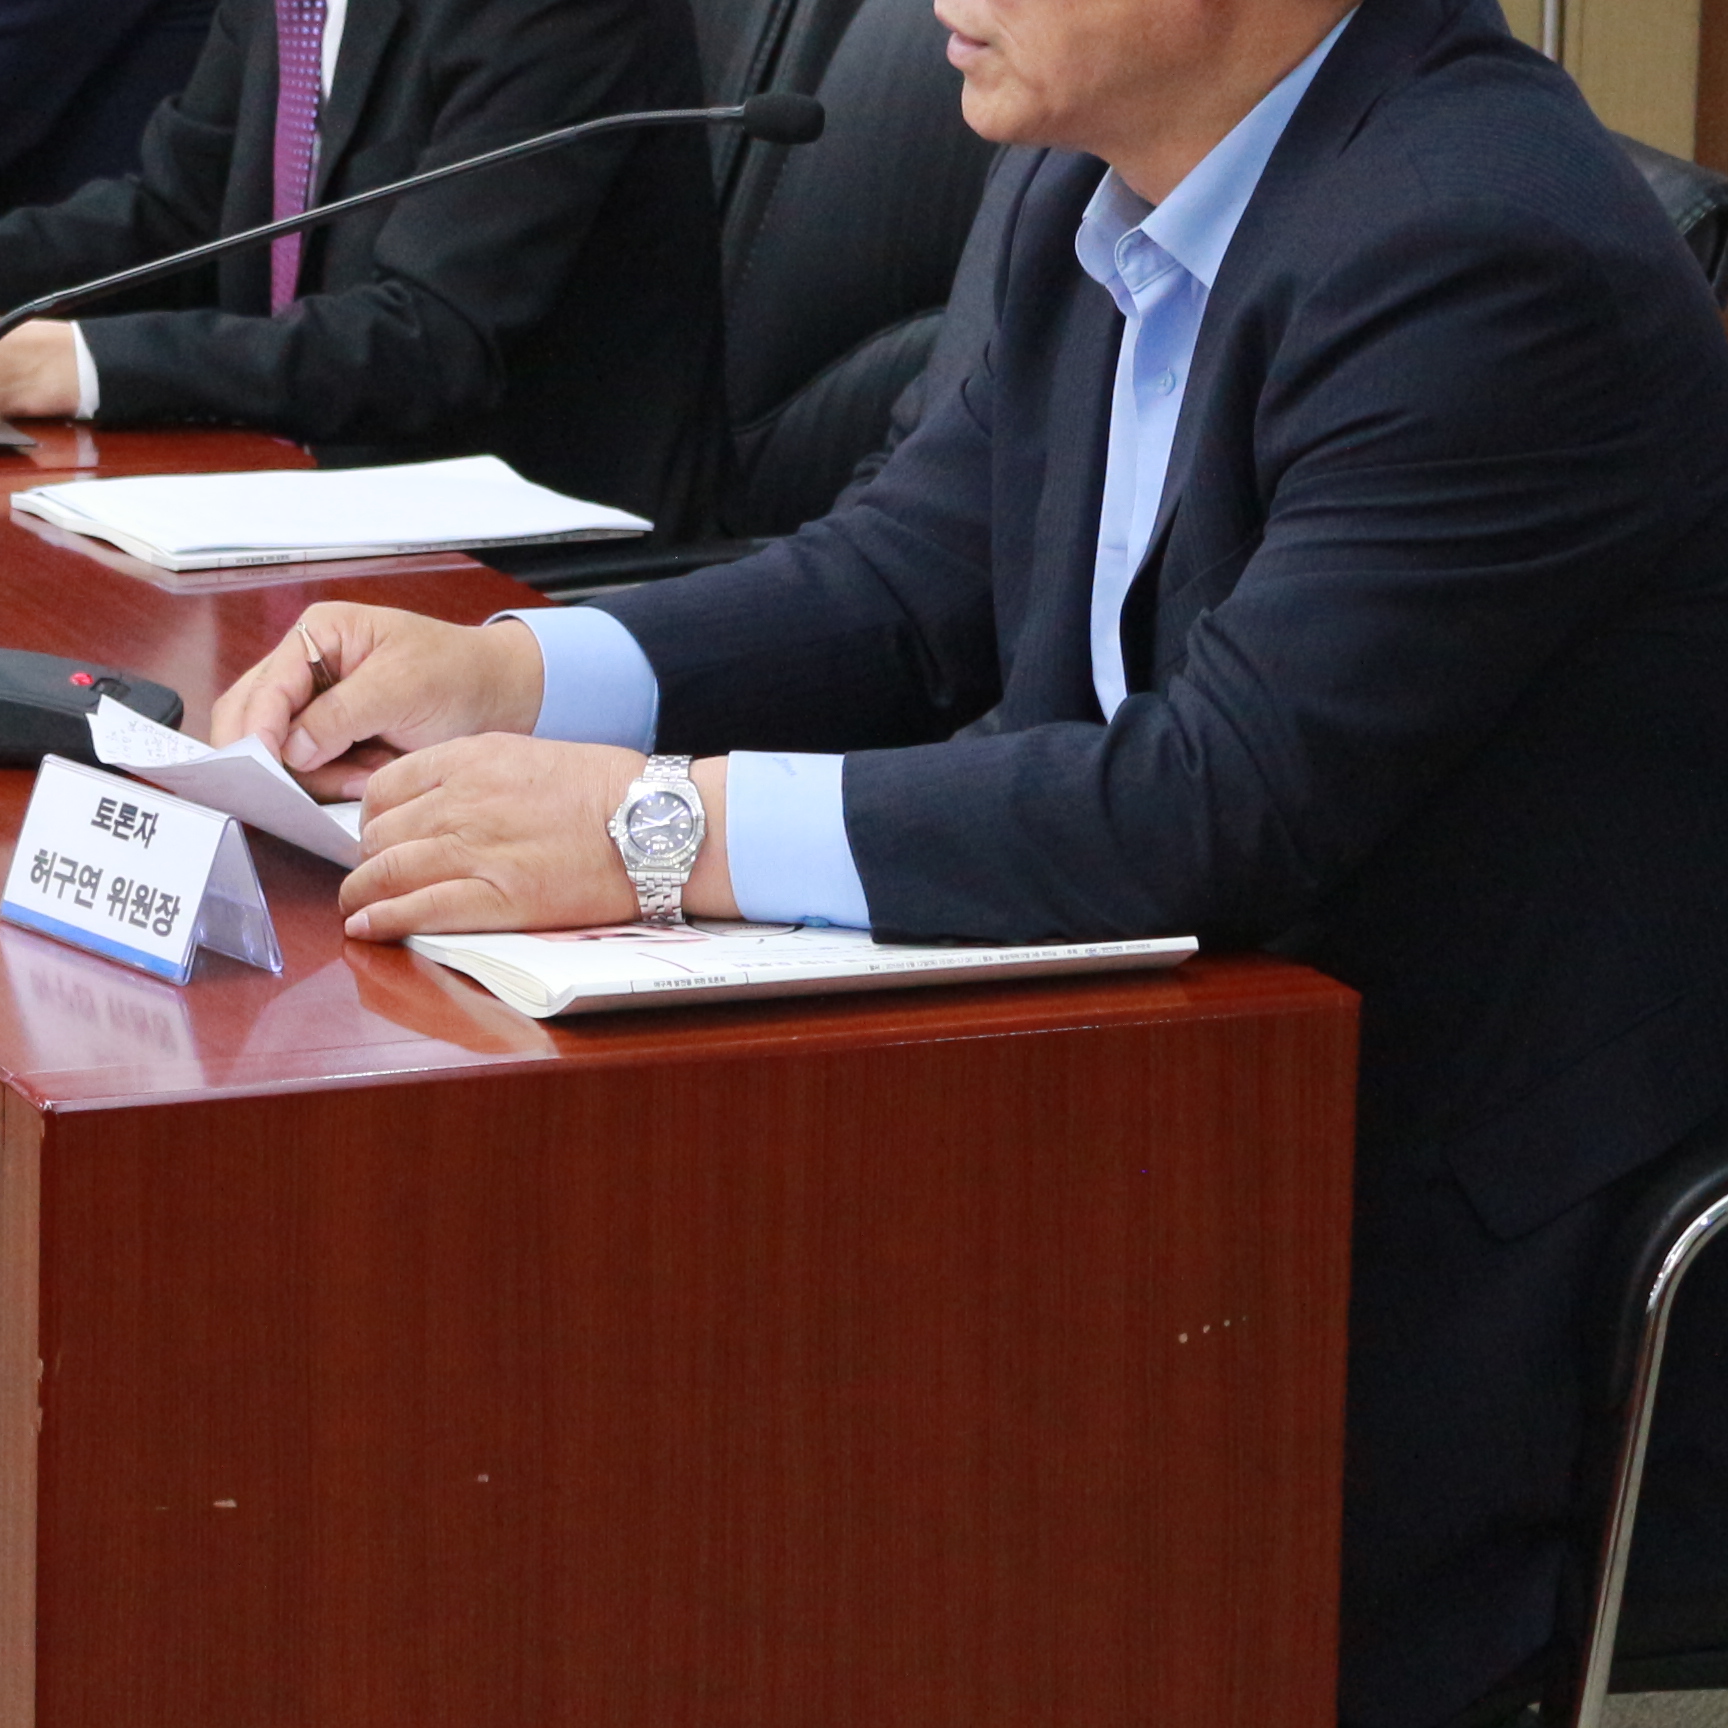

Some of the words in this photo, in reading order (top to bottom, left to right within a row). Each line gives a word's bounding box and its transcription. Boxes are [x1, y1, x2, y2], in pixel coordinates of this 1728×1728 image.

[91, 797, 159, 849] 토론자
[30, 848, 103, 909] 허구연
[106, 876, 181, 937] 위원장
